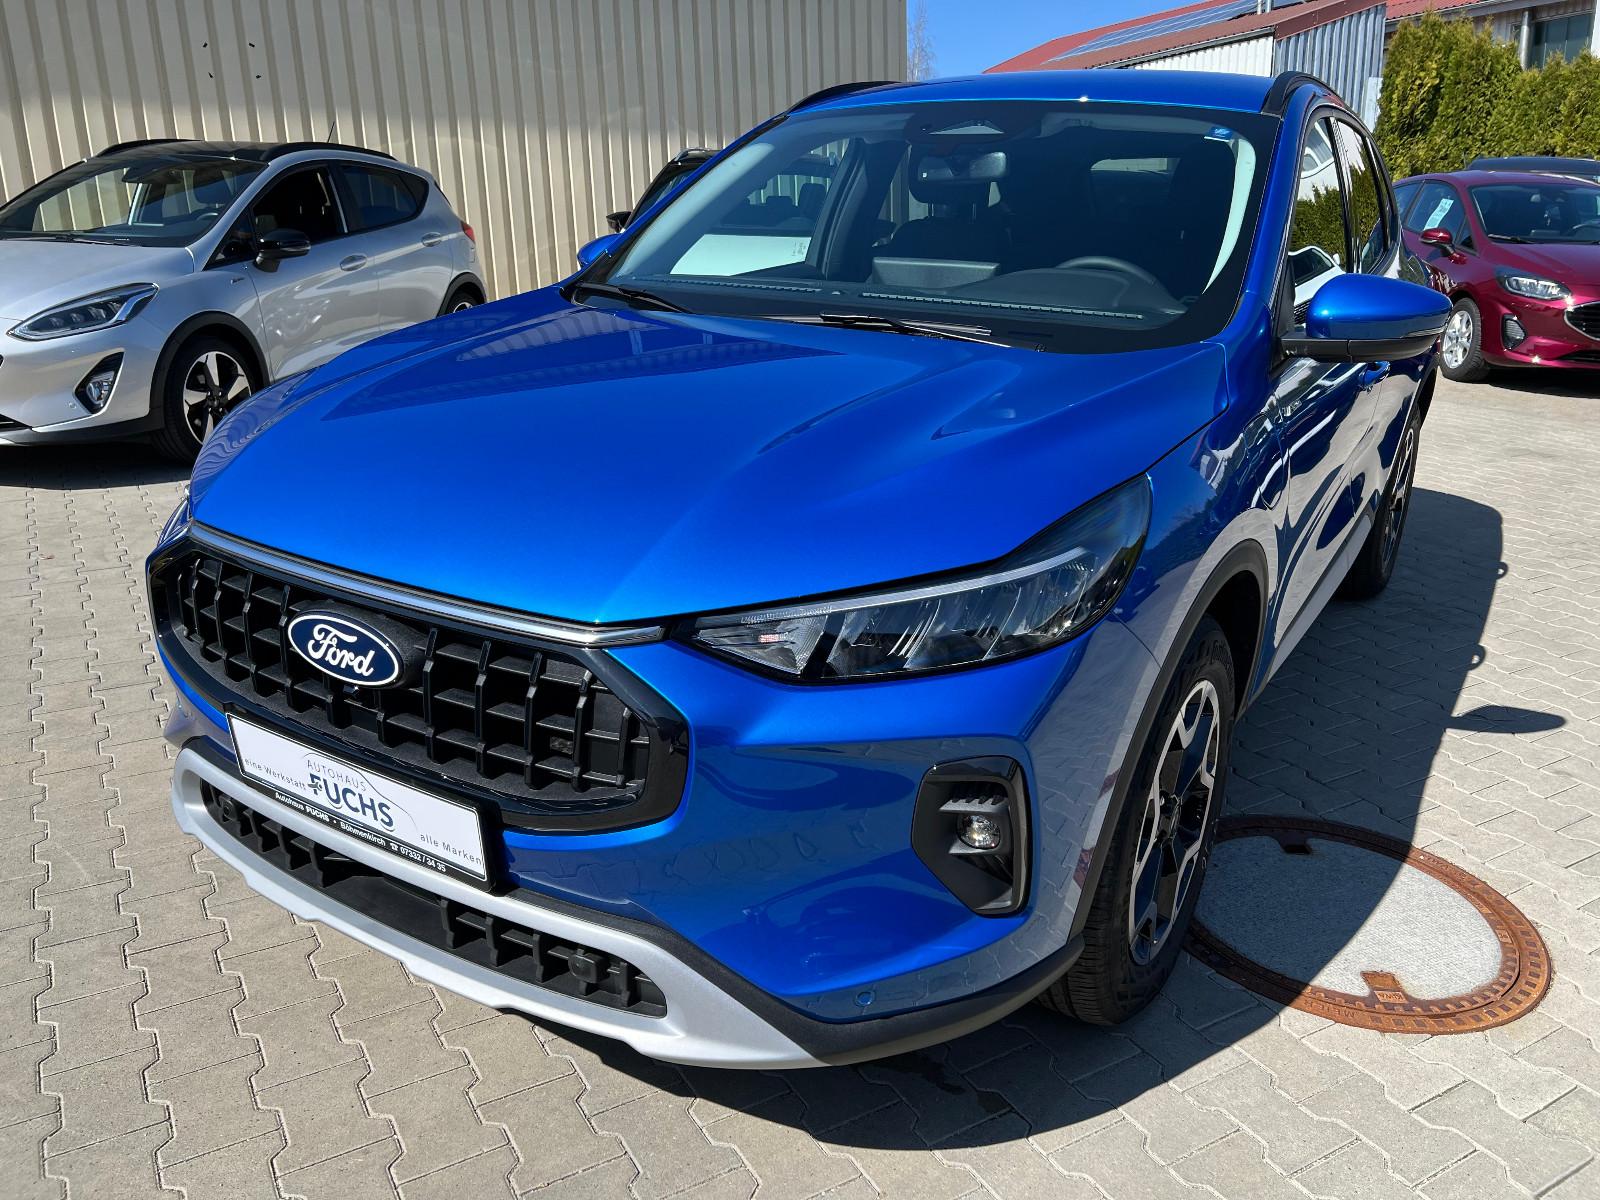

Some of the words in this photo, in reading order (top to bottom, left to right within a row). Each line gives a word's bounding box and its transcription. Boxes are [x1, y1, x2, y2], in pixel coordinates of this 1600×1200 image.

[307, 623, 376, 677] Ford
[244, 758, 263, 771] eine
[264, 765, 307, 791] Werkstatt
[307, 759, 367, 792] AUTOHAUS
[308, 772, 394, 828] FUCHS
[275, 792, 305, 811] Autohaus
[305, 805, 330, 822] FUCHS
[400, 845, 422, 861] 07332
[420, 833, 439, 846] alle
[442, 842, 482, 864] Marken
